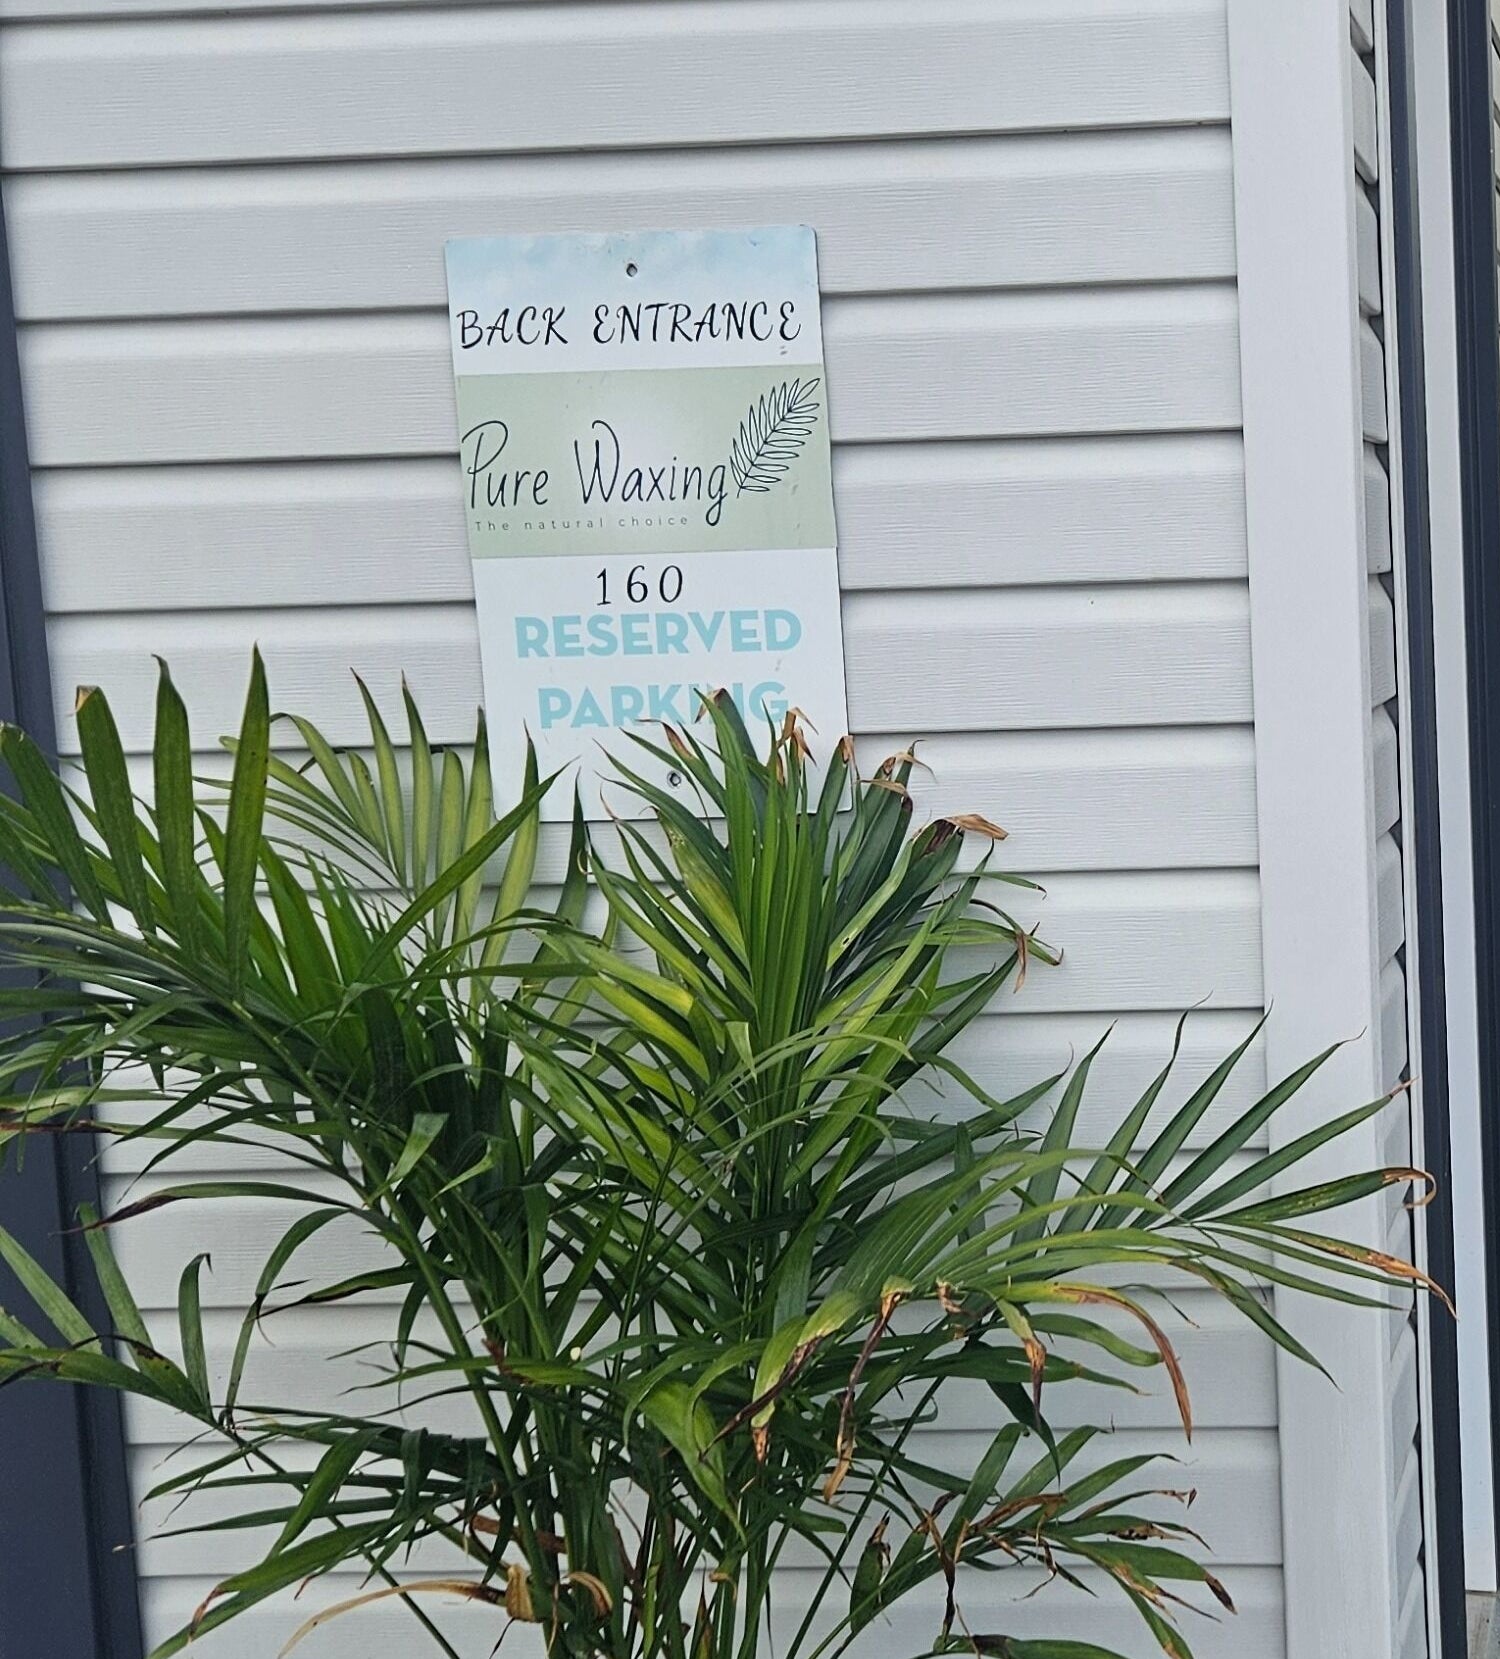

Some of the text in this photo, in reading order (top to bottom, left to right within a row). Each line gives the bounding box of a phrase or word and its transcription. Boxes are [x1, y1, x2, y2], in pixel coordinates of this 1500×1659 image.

[457, 301, 801, 349] BACK ENTRANCE
[461, 419, 728, 526] Pure Waxing
[475, 515, 689, 532] The natural choice
[596, 565, 683, 606] 160
[515, 608, 802, 658] RESERVED
